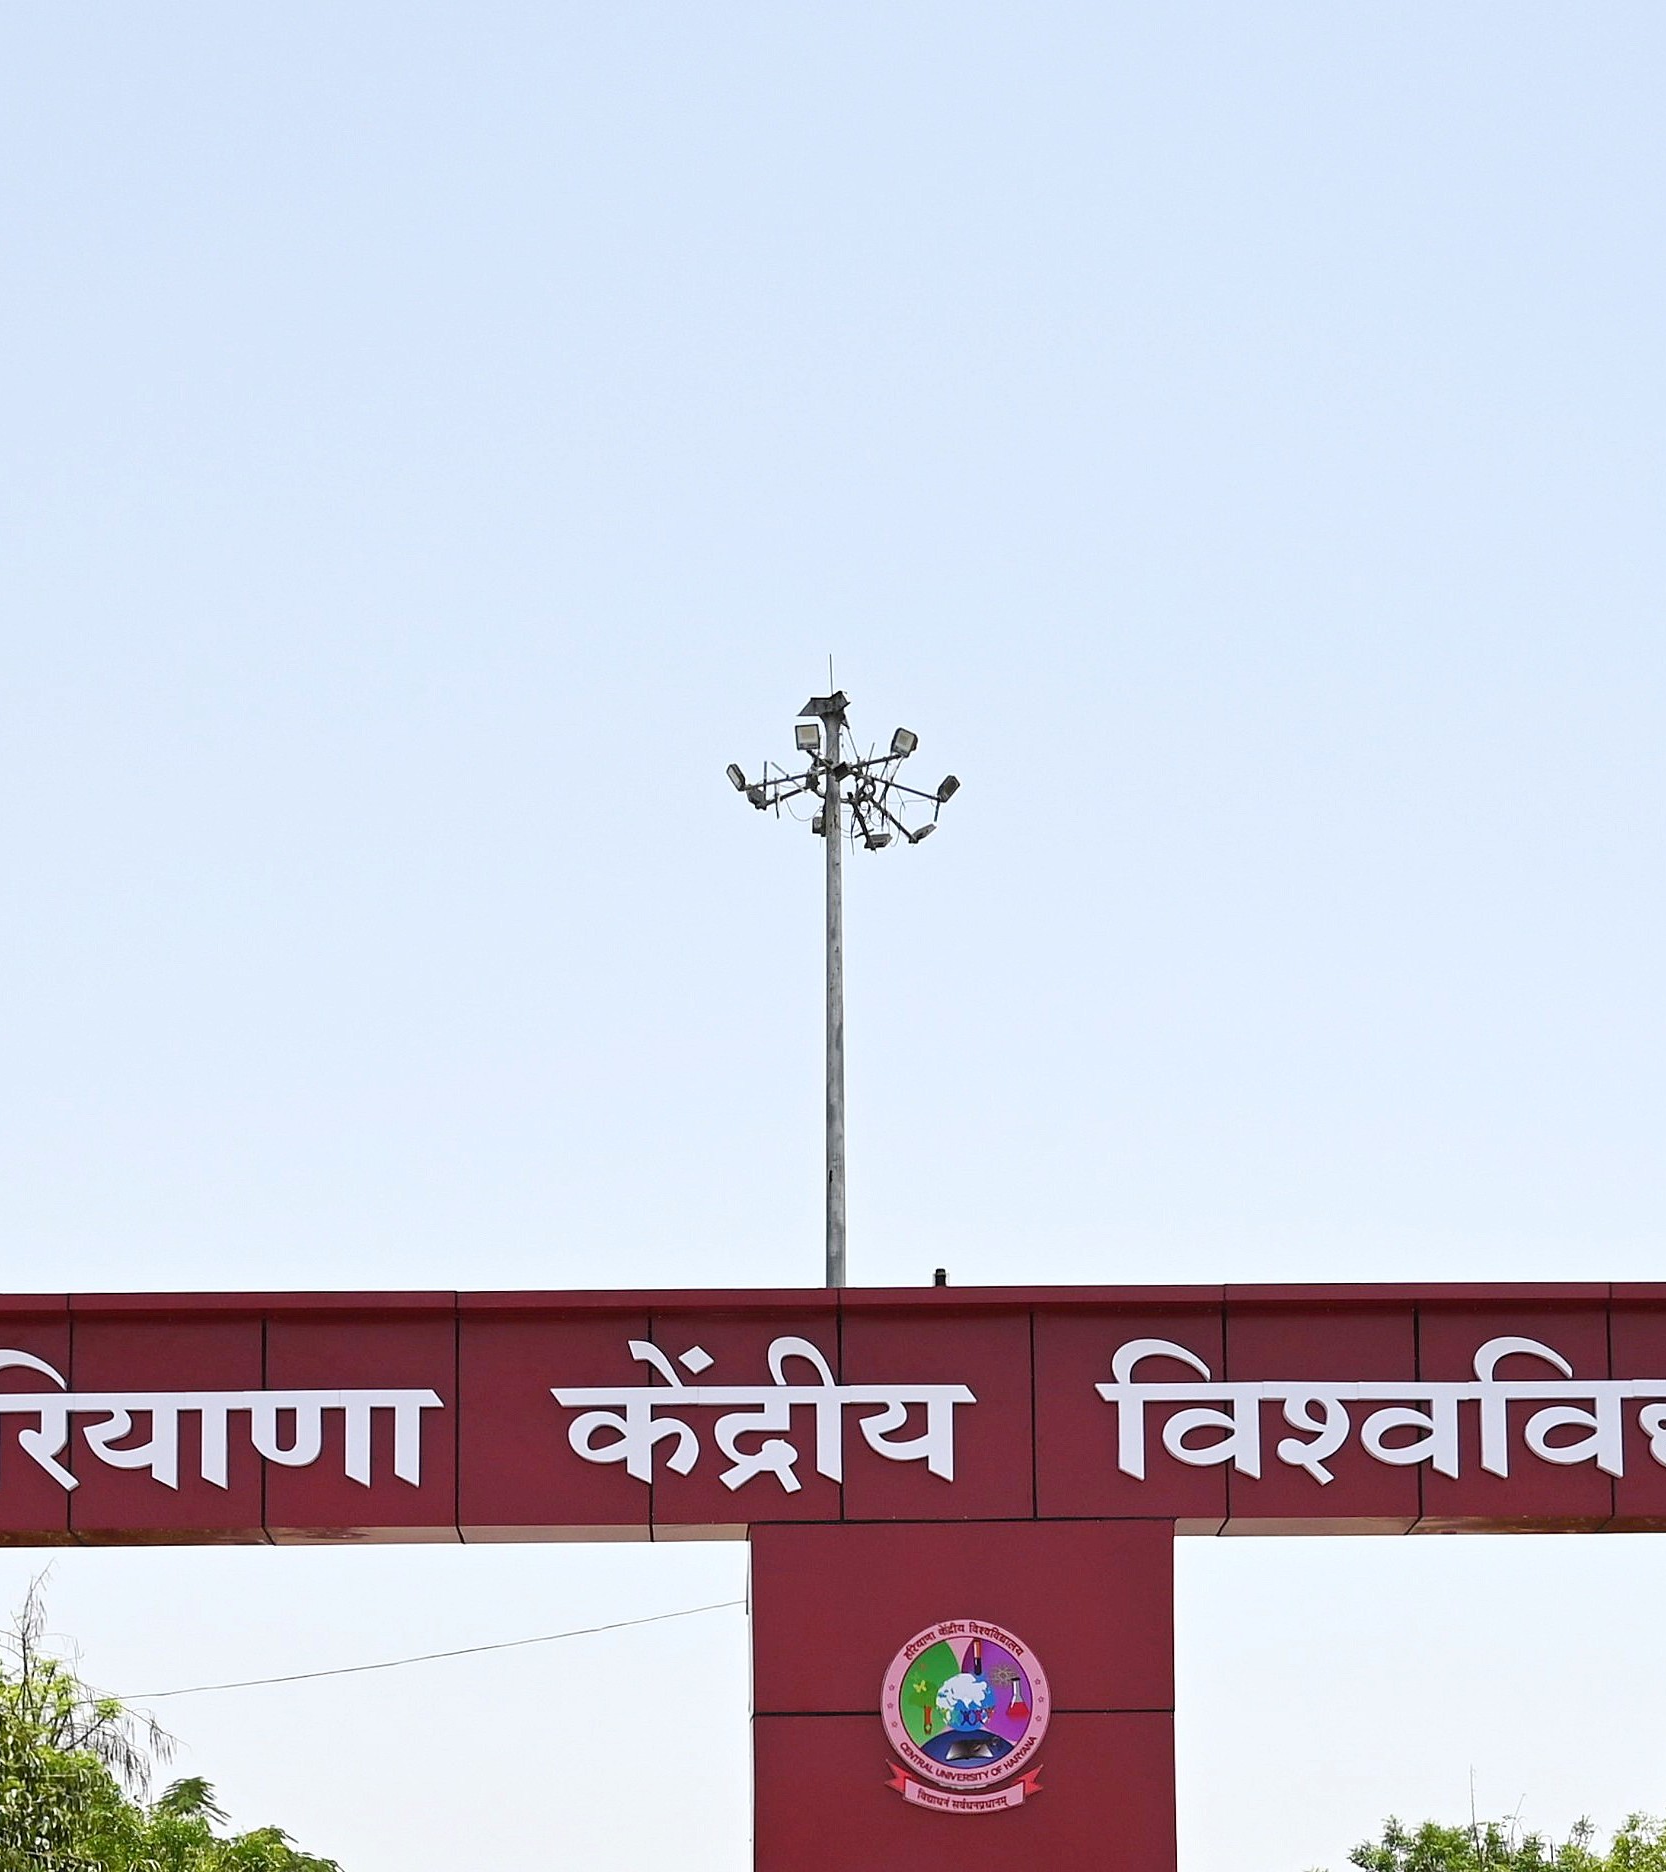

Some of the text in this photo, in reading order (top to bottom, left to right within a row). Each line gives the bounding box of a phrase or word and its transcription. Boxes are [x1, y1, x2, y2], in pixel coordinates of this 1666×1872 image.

[550, 1335, 977, 1493] केंद्रीय
[903, 1631, 936, 1661] हरियाणा
[969, 1621, 1024, 1657] विश्वविद्यालय
[900, 1735, 1038, 1782] CENTRAL UNIVERSITY OF HARYANA
